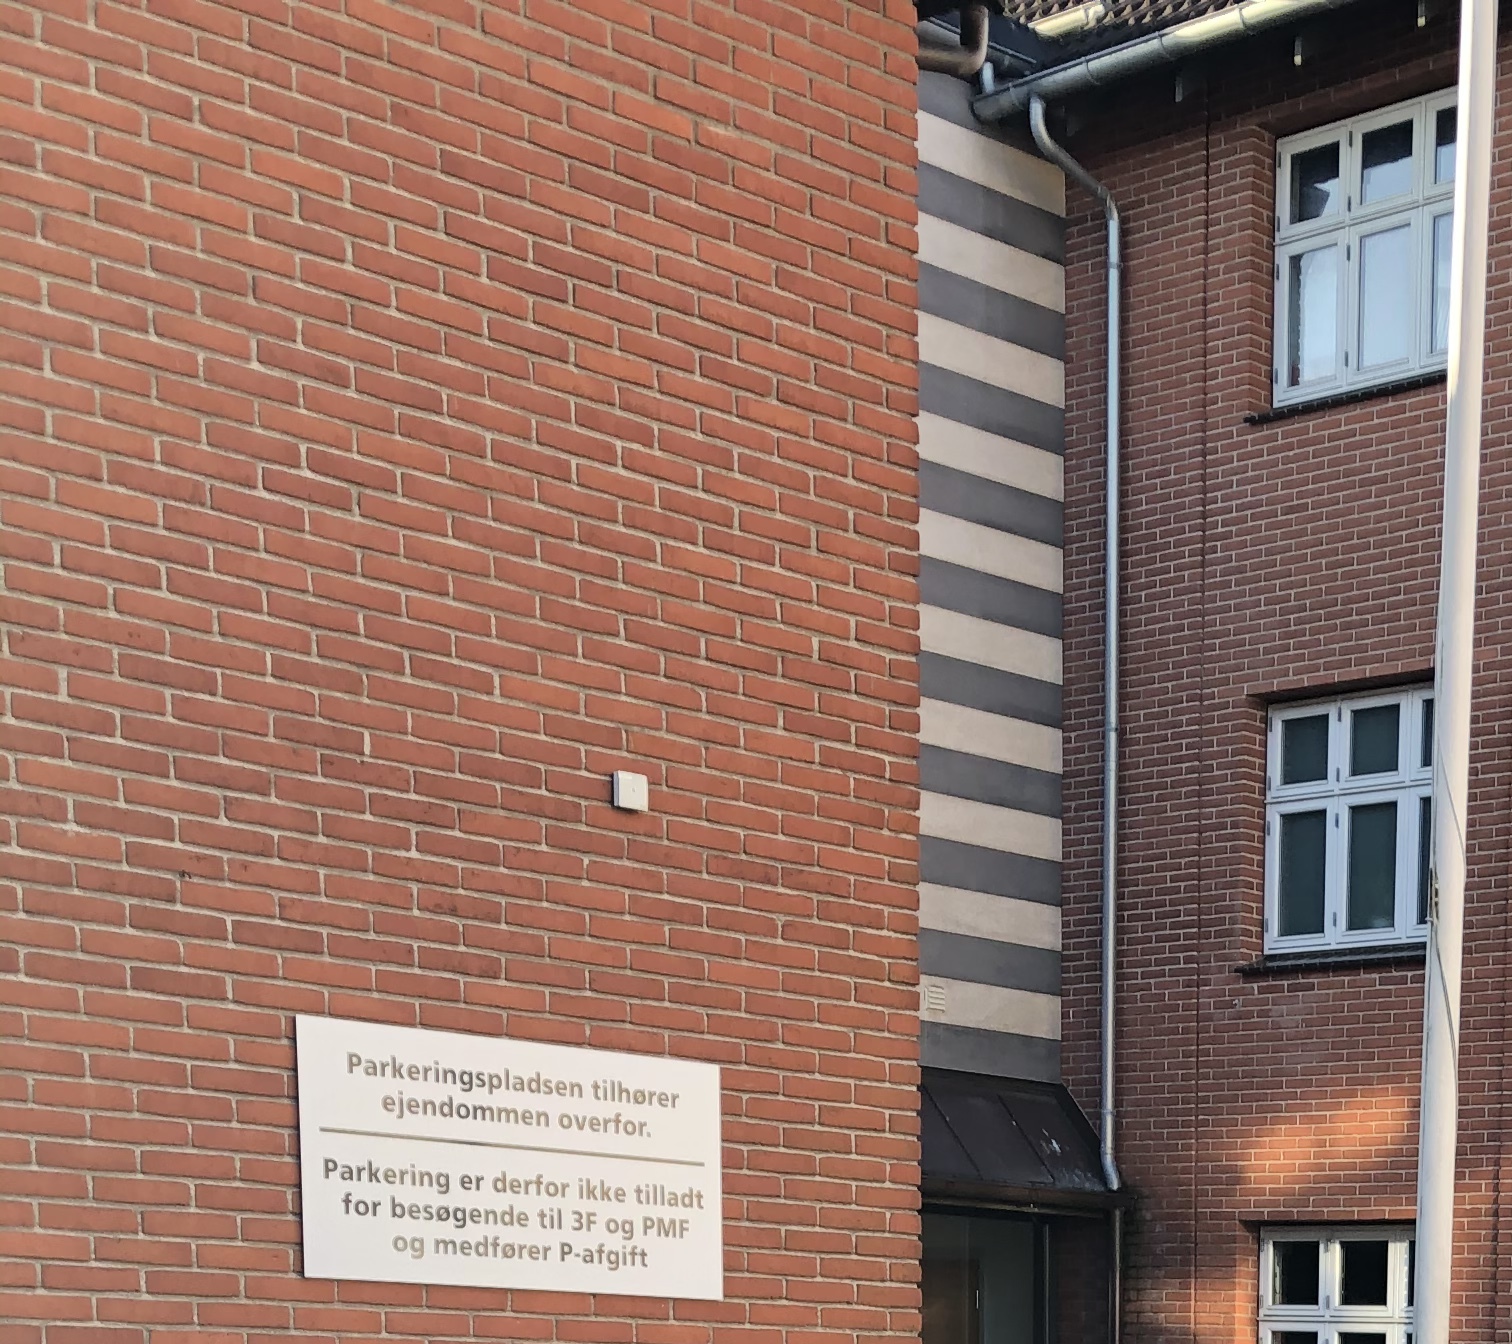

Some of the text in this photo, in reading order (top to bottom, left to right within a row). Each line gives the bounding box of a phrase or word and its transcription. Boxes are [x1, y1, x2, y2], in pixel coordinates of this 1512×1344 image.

[346, 1051, 680, 1109] Parkeringspladsen tilhører
[381, 1090, 652, 1138] ejendommen overfor.
[323, 1157, 704, 1210] Parkering er derfor ikke tilladt
[341, 1191, 690, 1241] for besøgende til 3F og PMF
[392, 1234, 648, 1272] og medfører P-afgift
